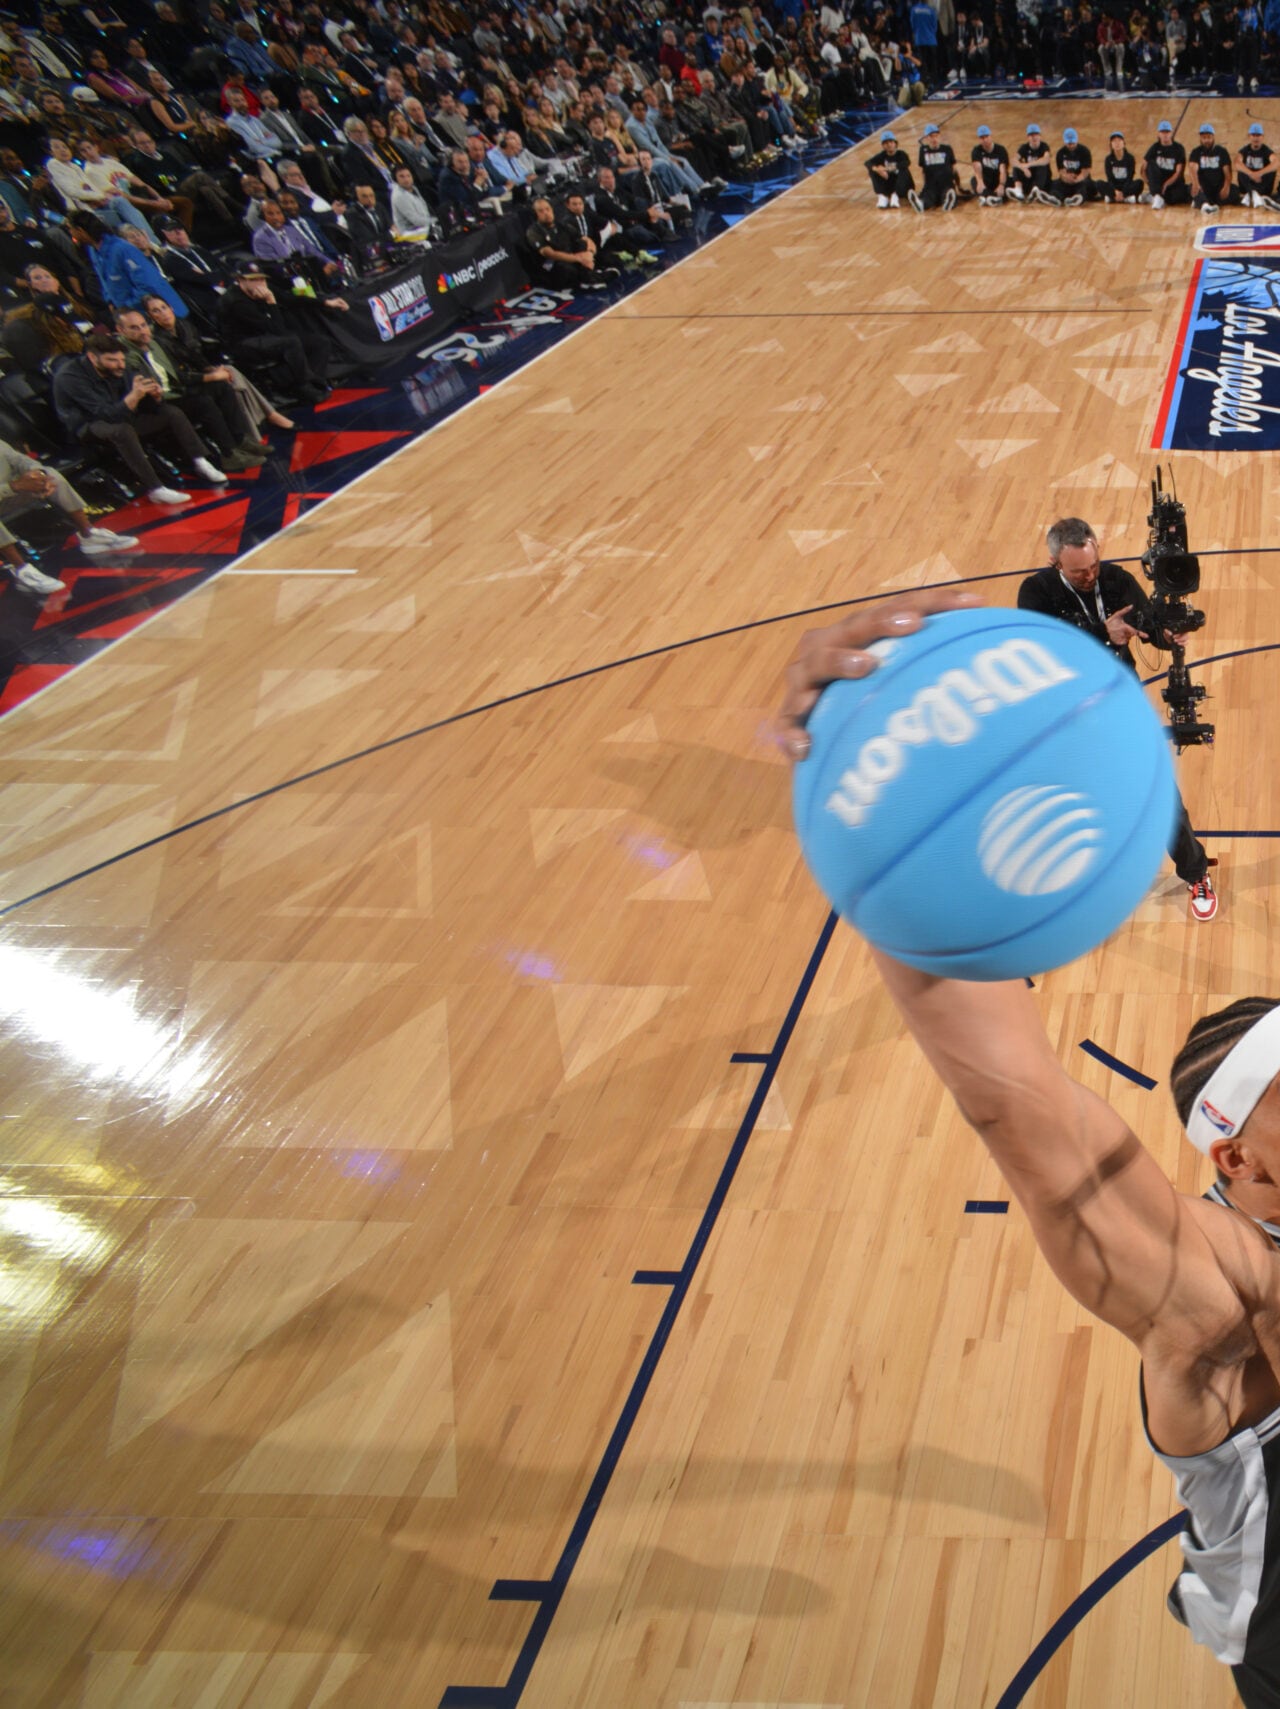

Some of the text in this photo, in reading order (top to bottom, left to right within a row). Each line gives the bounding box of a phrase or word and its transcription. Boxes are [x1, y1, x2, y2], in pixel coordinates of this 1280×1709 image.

[453, 247, 508, 287] NBC peacock
[825, 638, 1079, 828] Wilson
